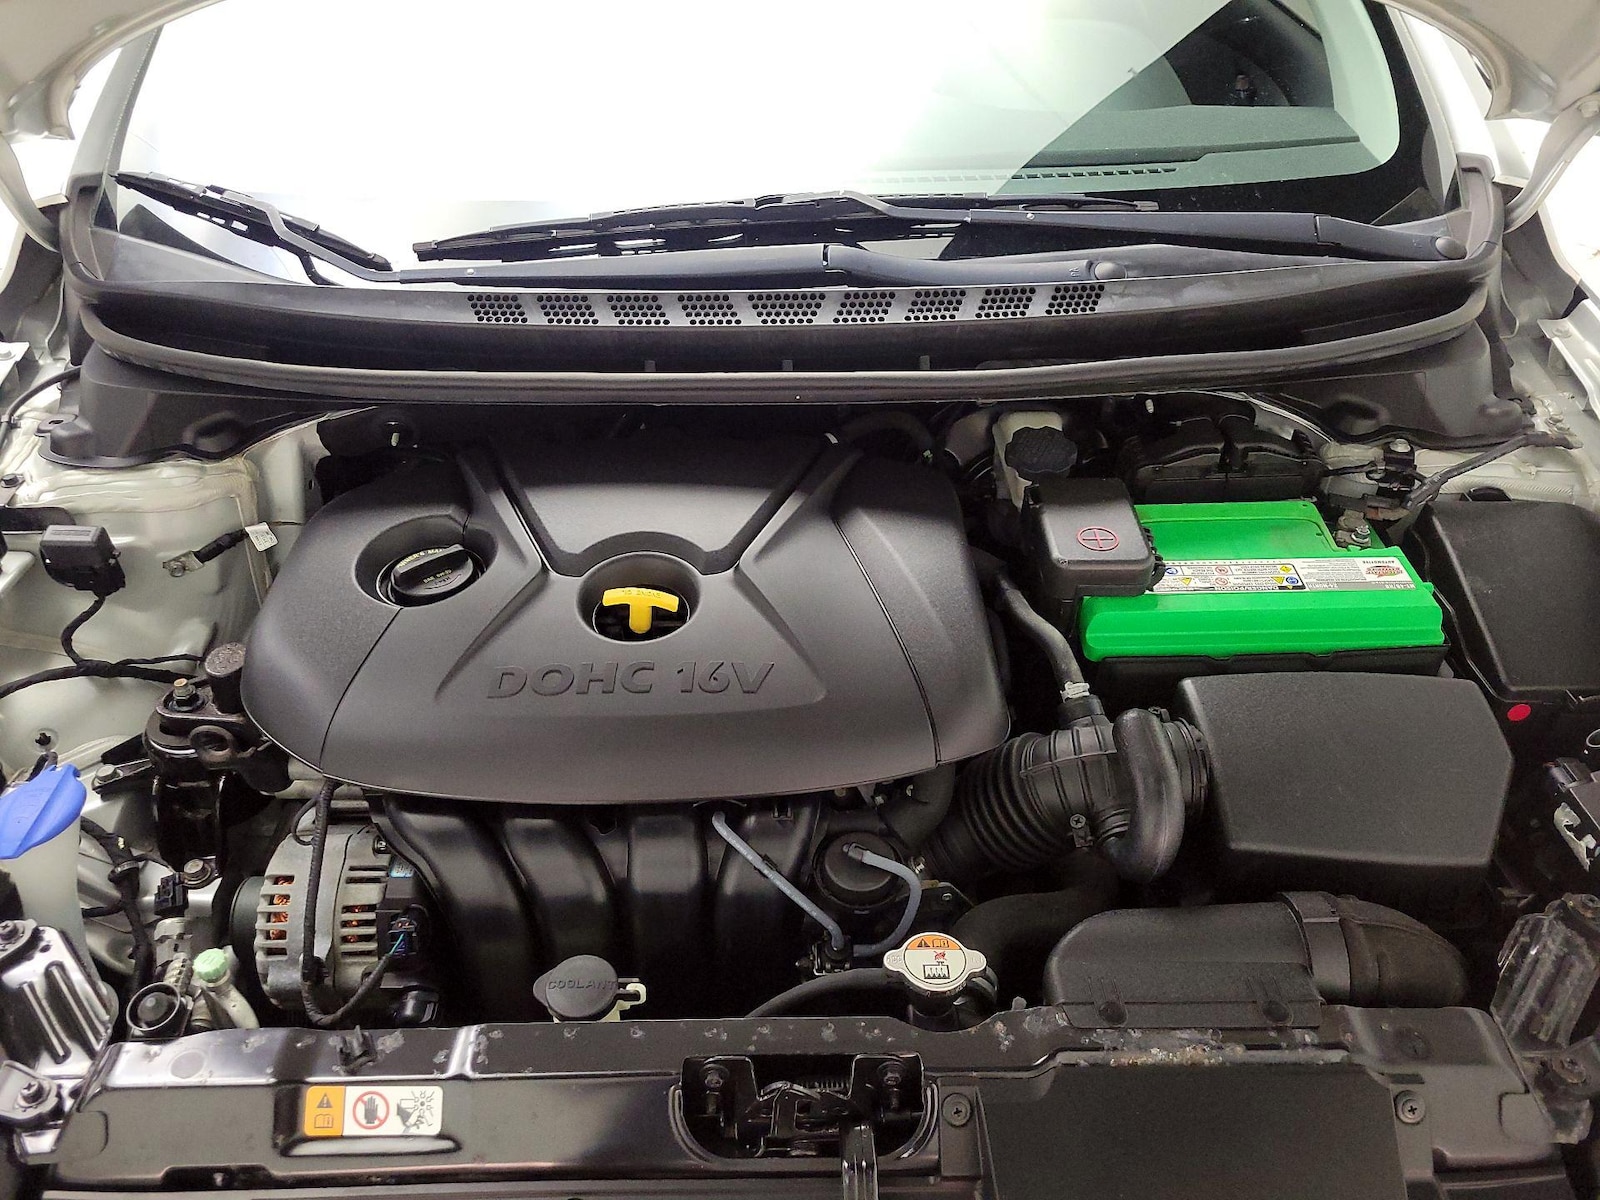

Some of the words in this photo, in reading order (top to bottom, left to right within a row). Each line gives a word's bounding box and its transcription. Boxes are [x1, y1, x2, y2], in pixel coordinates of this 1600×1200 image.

[487, 660, 655, 699] DOHC
[676, 661, 775, 694] 16V
[548, 978, 617, 990] COOLANT
